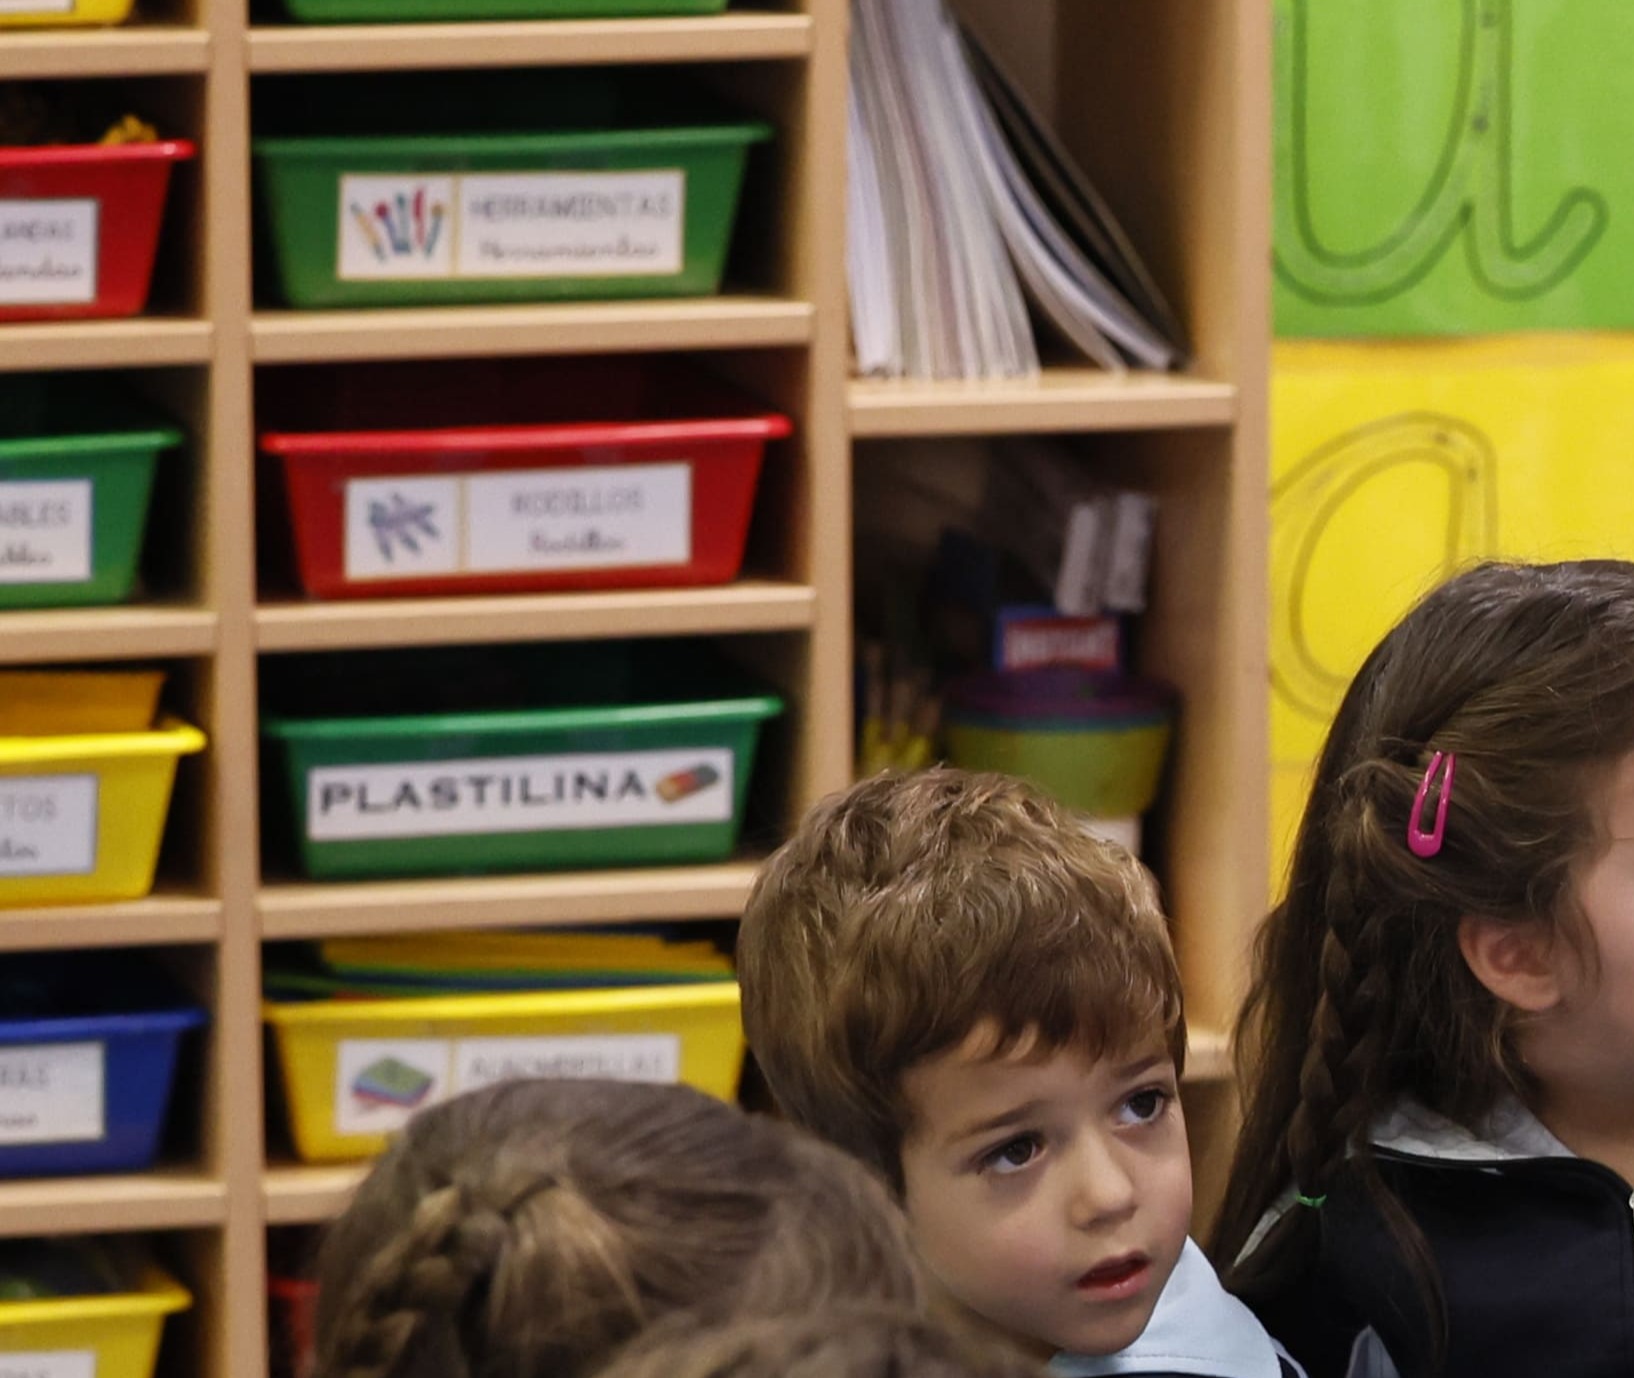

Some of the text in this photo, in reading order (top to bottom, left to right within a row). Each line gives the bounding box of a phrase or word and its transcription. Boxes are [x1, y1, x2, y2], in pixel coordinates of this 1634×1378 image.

[470, 191, 672, 220] HERRAMIENTAS
[512, 486, 645, 517] RODILLOS
[320, 769, 647, 815] PLASTILINA
